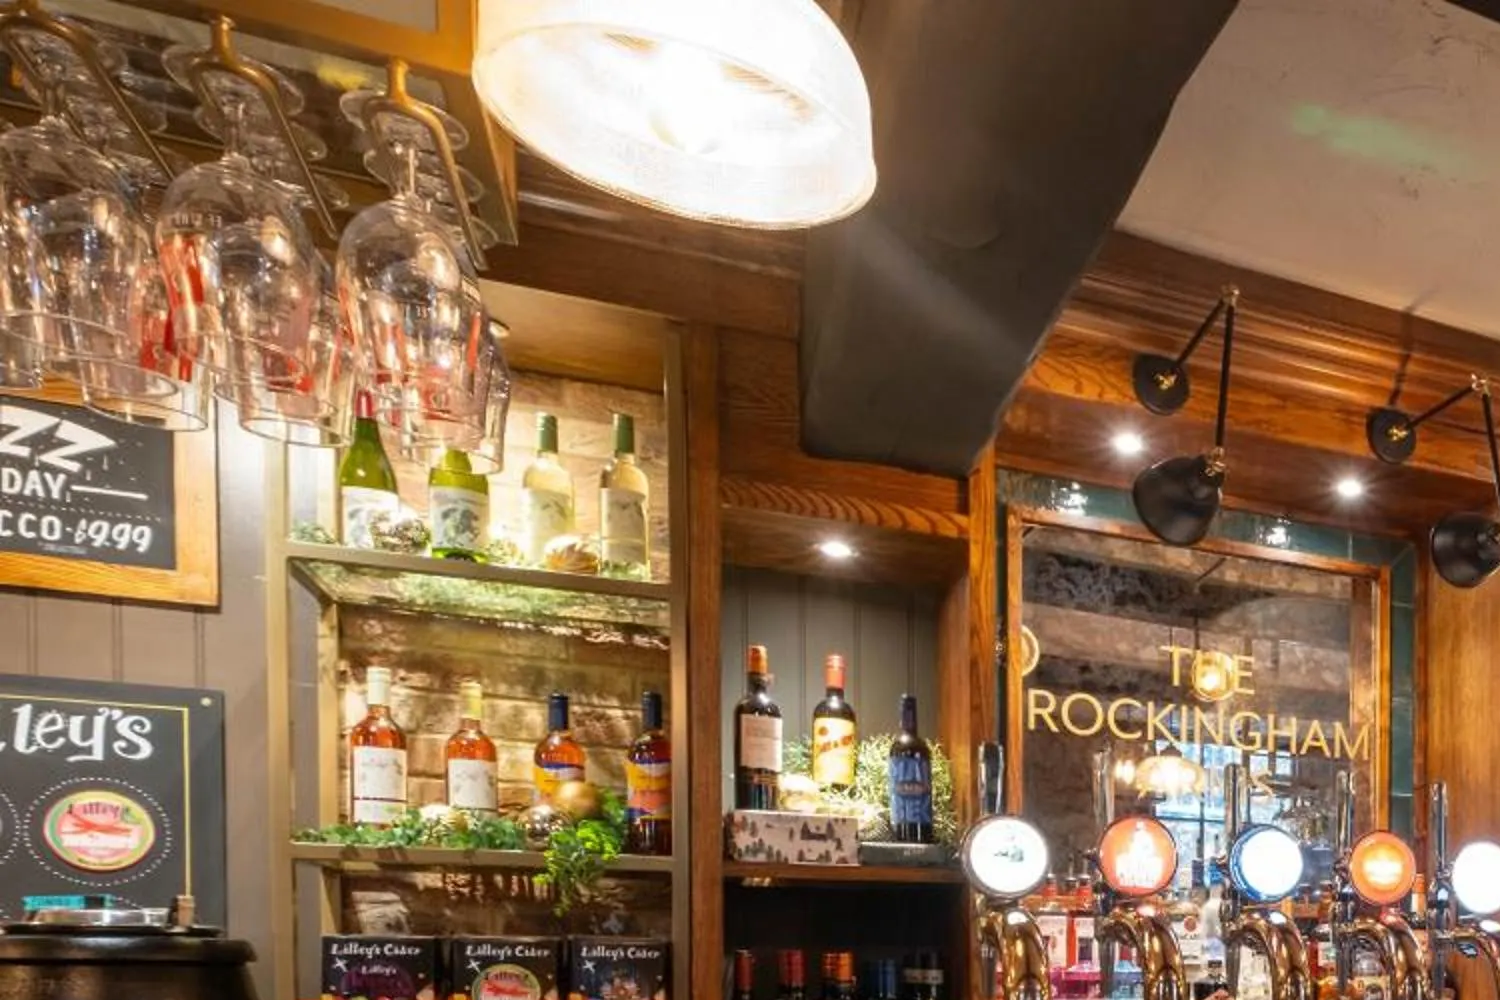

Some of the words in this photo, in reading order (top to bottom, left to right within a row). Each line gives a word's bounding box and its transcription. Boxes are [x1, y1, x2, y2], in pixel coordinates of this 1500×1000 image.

[1, 466, 67, 499] DAY
[0, 703, 155, 761] ley's
[1026, 688, 1371, 762] ROCKINGHAM
[465, 943, 513, 960] Lilley's
[514, 945, 550, 958] Cider
